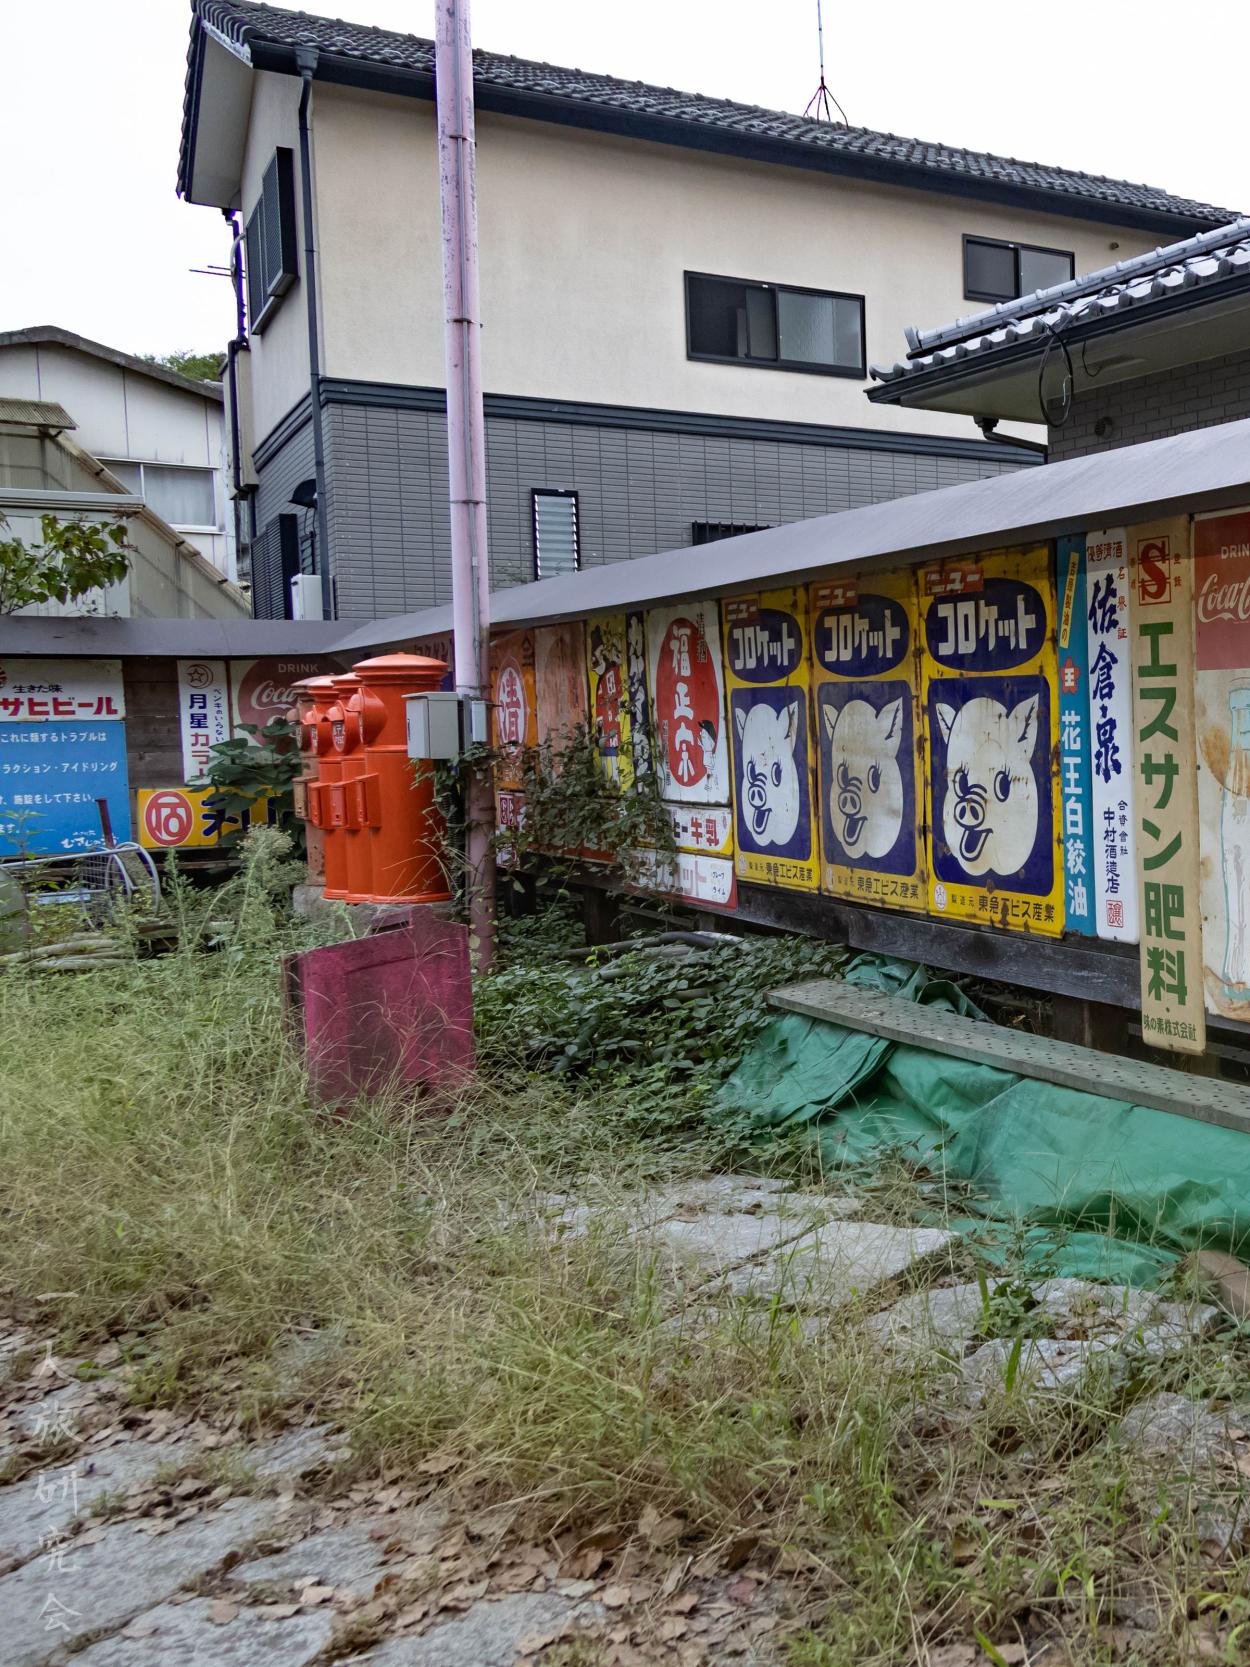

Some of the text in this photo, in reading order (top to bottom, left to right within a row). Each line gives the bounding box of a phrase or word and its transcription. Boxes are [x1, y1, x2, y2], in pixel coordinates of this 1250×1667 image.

[927, 571, 981, 593] ニュー
[816, 588, 857, 608] ニュー
[727, 603, 757, 621] ニュー
[823, 609, 901, 662] コロケット
[937, 594, 1037, 656] コロケット
[733, 622, 796, 670] コロケット
[279, 664, 319, 673] DRINK
[13, 684, 63, 693] 生きた味
[1138, 621, 1187, 1006] エスサン肥料
[1143, 1014, 1198, 1042] 味の素株式会社
